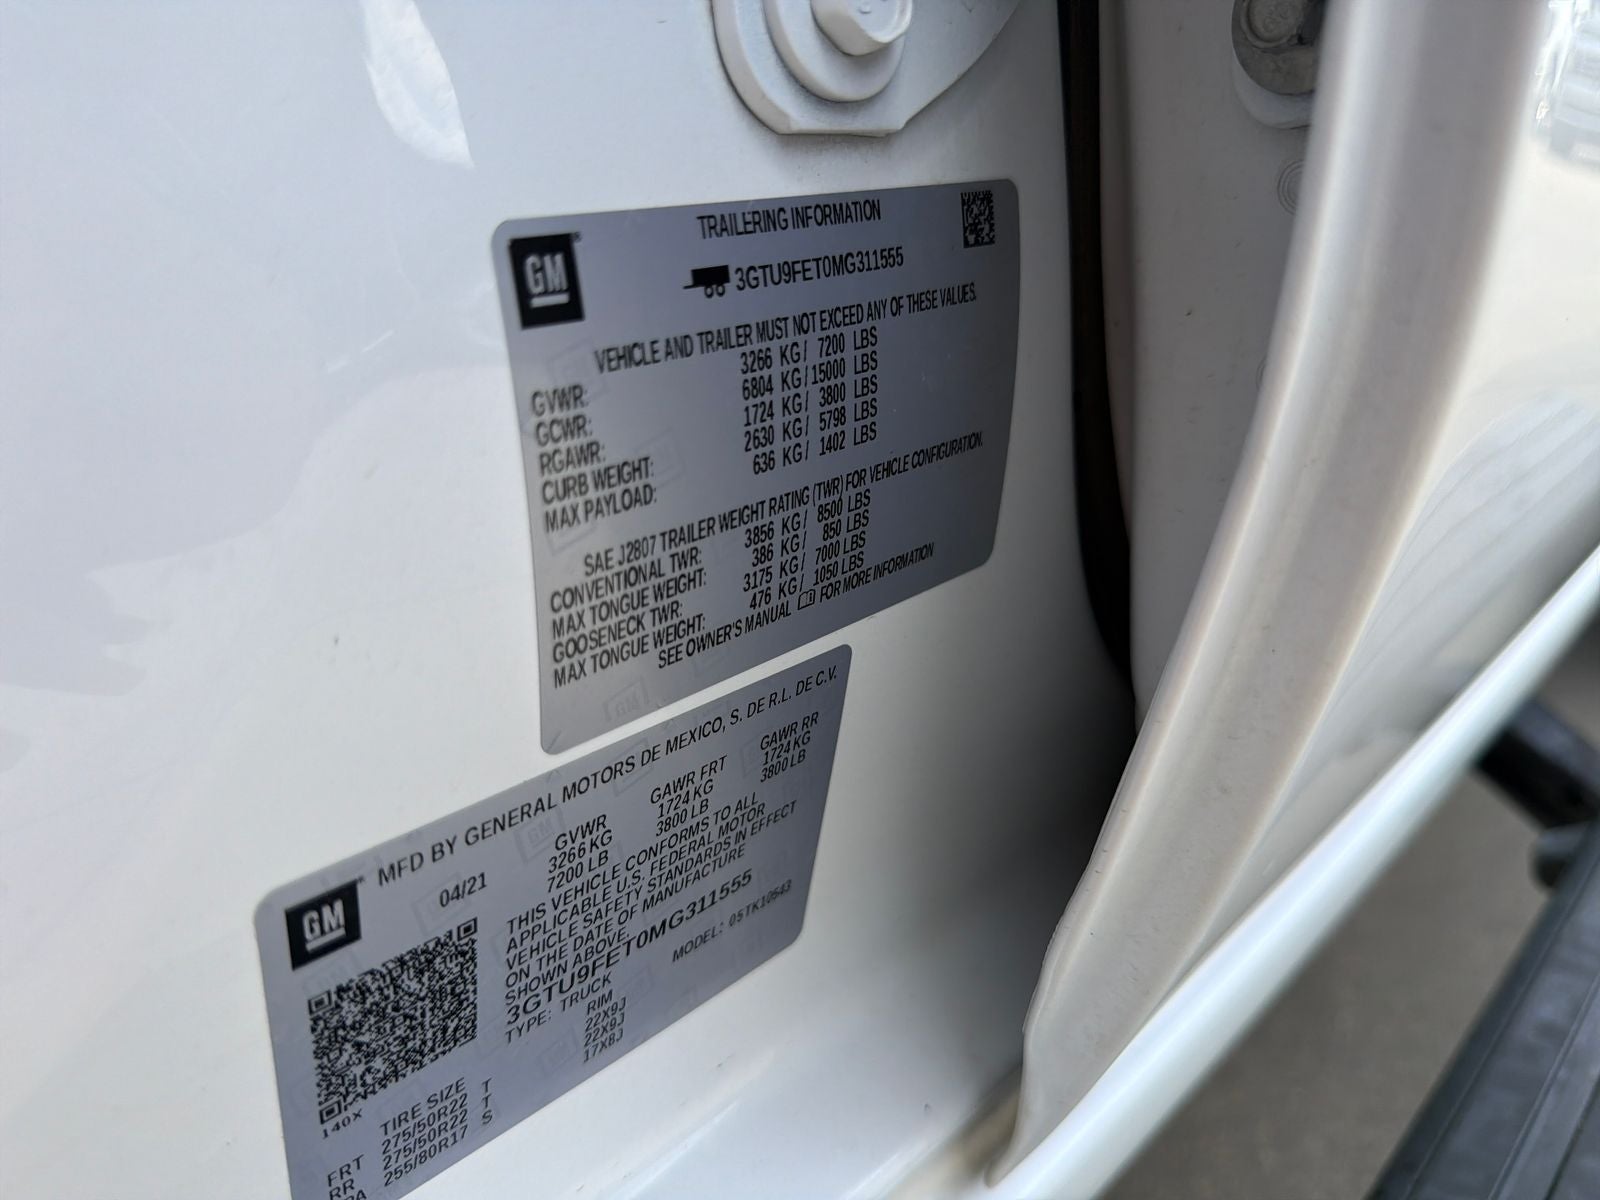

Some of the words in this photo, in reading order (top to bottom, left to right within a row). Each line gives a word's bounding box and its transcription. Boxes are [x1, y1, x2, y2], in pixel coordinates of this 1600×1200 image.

[524, 252, 569, 295] GM
[697, 207, 788, 239] TRAILERING
[791, 199, 881, 229] INFORMATION
[735, 246, 904, 291] 3GTU9FET0MG311555
[531, 384, 589, 417] GVWR:
[740, 347, 773, 375] 3266
[817, 332, 845, 358] 7200
[853, 325, 878, 351] LBS
[593, 339, 659, 374] VEHICLE
[664, 334, 693, 361] AND
[696, 323, 752, 357] TRAILER
[756, 317, 790, 344] MUST
[792, 311, 816, 338] NOT
[819, 303, 864, 331] EXCEED
[866, 298, 888, 322] ANY
[890, 295, 904, 317] OF
[906, 289, 938, 314] THESE
[535, 414, 593, 447] GCWR:
[742, 374, 774, 401] 6804
[853, 350, 878, 375] LBS
[539, 440, 607, 477] RGAWR:
[743, 400, 775, 427] 1724
[819, 381, 846, 407] 3800
[854, 374, 878, 399] LBS
[542, 472, 589, 505] CURB
[592, 455, 654, 492] WEIGHT:
[744, 425, 775, 452] 2630
[819, 406, 846, 432] 5798
[854, 398, 878, 422] LBS
[545, 503, 581, 533] MAX
[584, 484, 657, 518] PAYLOAD:
[753, 450, 775, 475] 636
[819, 430, 846, 456] 1402
[853, 421, 877, 446] LBS
[584, 547, 614, 577] SAE
[618, 535, 657, 566] J2807
[660, 516, 716, 552] TRAILER
[718, 500, 766, 533] WEIGHT
[769, 486, 810, 517] RATING
[812, 475, 844, 507] (TWR)
[845, 468, 867, 491] FOR
[869, 454, 910, 483] VEHICLE
[550, 560, 665, 613] CONVENTIONAL
[669, 546, 702, 574] TWR:
[744, 521, 774, 548] 3856
[817, 497, 843, 523] 8500
[848, 488, 871, 513] LBS
[552, 610, 586, 640] MAX
[589, 587, 650, 626] TONGUE
[653, 567, 707, 603] WEIGHT:
[752, 542, 774, 567] 386
[822, 519, 841, 542] 850
[846, 509, 869, 533] LBS
[552, 613, 645, 663] GOOSENECK
[649, 600, 683, 627] TWR:
[743, 566, 773, 592] 3175
[815, 540, 840, 565] 7000
[843, 530, 866, 555] LBS
[658, 643, 683, 669] SEE
[685, 621, 742, 657] OWNER'S
[744, 602, 791, 634] MANUAL
[820, 580, 841, 603] FOR
[842, 566, 872, 593] MORE
[873, 542, 935, 581] INFORMATION
[554, 658, 587, 689] MAX
[590, 634, 650, 673] TONGUE
[653, 613, 706, 649] WEIGHT:
[750, 586, 772, 610] 476
[813, 560, 838, 586] 1050
[841, 551, 864, 575] LBS
[378, 851, 424, 886] MFD
[431, 835, 458, 863] BY
[464, 793, 557, 846] GENERAL
[562, 754, 635, 804] MOTORS
[641, 744, 661, 767] DE
[665, 716, 726, 756] MEXICO,
[730, 708, 743, 725] S.
[747, 698, 765, 719] DE
[768, 687, 792, 708] R.L.
[796, 674, 813, 696] DE
[815, 665, 837, 686] C.V.
[547, 863, 584, 893] 7200
[588, 849, 609, 872] LB
[656, 813, 688, 837] 3800
[691, 798, 709, 818] LB
[760, 760, 789, 783] 3800
[790, 749, 806, 768] LB
[548, 841, 586, 873] 3266
[589, 829, 612, 853] KG
[657, 791, 690, 819] 1724
[693, 779, 714, 801] KG
[762, 743, 791, 766] 1724
[792, 730, 811, 749] KG
[554, 814, 607, 851] GVWR
[650, 771, 696, 804] GAWR
[700, 754, 728, 782] FRT
[760, 720, 798, 750] GAWR
[801, 711, 819, 732] RR
[302, 898, 345, 941] GM
[439, 872, 488, 908] 04/21
[505, 963, 530, 988] ON
[536, 942, 568, 972] THE
[573, 917, 614, 952] DATE
[617, 903, 638, 926] OF
[642, 843, 746, 913] MANUFACTURE
[506, 920, 578, 970] VEHICLE
[583, 885, 643, 929] SAFETY
[647, 836, 731, 893] STANDARDS
[734, 828, 748, 845] IN
[750, 799, 797, 836] EFFECT
[507, 902, 546, 935] THIS
[551, 863, 622, 911] VEHICLE
[625, 817, 710, 872] CONFORMS
[713, 805, 731, 825] TO
[734, 791, 759, 814] ALL
[507, 885, 611, 954] APPLICABLE
[616, 869, 645, 894] U.S.
[650, 833, 714, 876] FEDERAL
[718, 802, 766, 840] MOTOR
[505, 960, 568, 1006] SHOWN
[572, 927, 629, 969] ABOVE.
[506, 868, 752, 1025] 3GTU9FET0MG311555
[672, 922, 724, 962] MODEL:
[380, 1104, 422, 1137] TIRE
[427, 1076, 466, 1111] SIZE
[587, 988, 613, 1015] RIM
[505, 1009, 552, 1045] TYPE:
[560, 971, 612, 1012] TRUCK
[327, 1154, 364, 1187] FRT
[381, 1093, 468, 1155] 275/50R22
[481, 1077, 493, 1094] T
[585, 996, 626, 1032] 22X9J
[329, 1178, 355, 1200] RR
[382, 1109, 468, 1171] 275/50R22
[482, 1094, 493, 1109] T
[584, 1012, 625, 1047] 22X9J
[384, 1124, 468, 1187] 255/80R17
[481, 1109, 493, 1125] S
[583, 1028, 623, 1063] 17X8J
